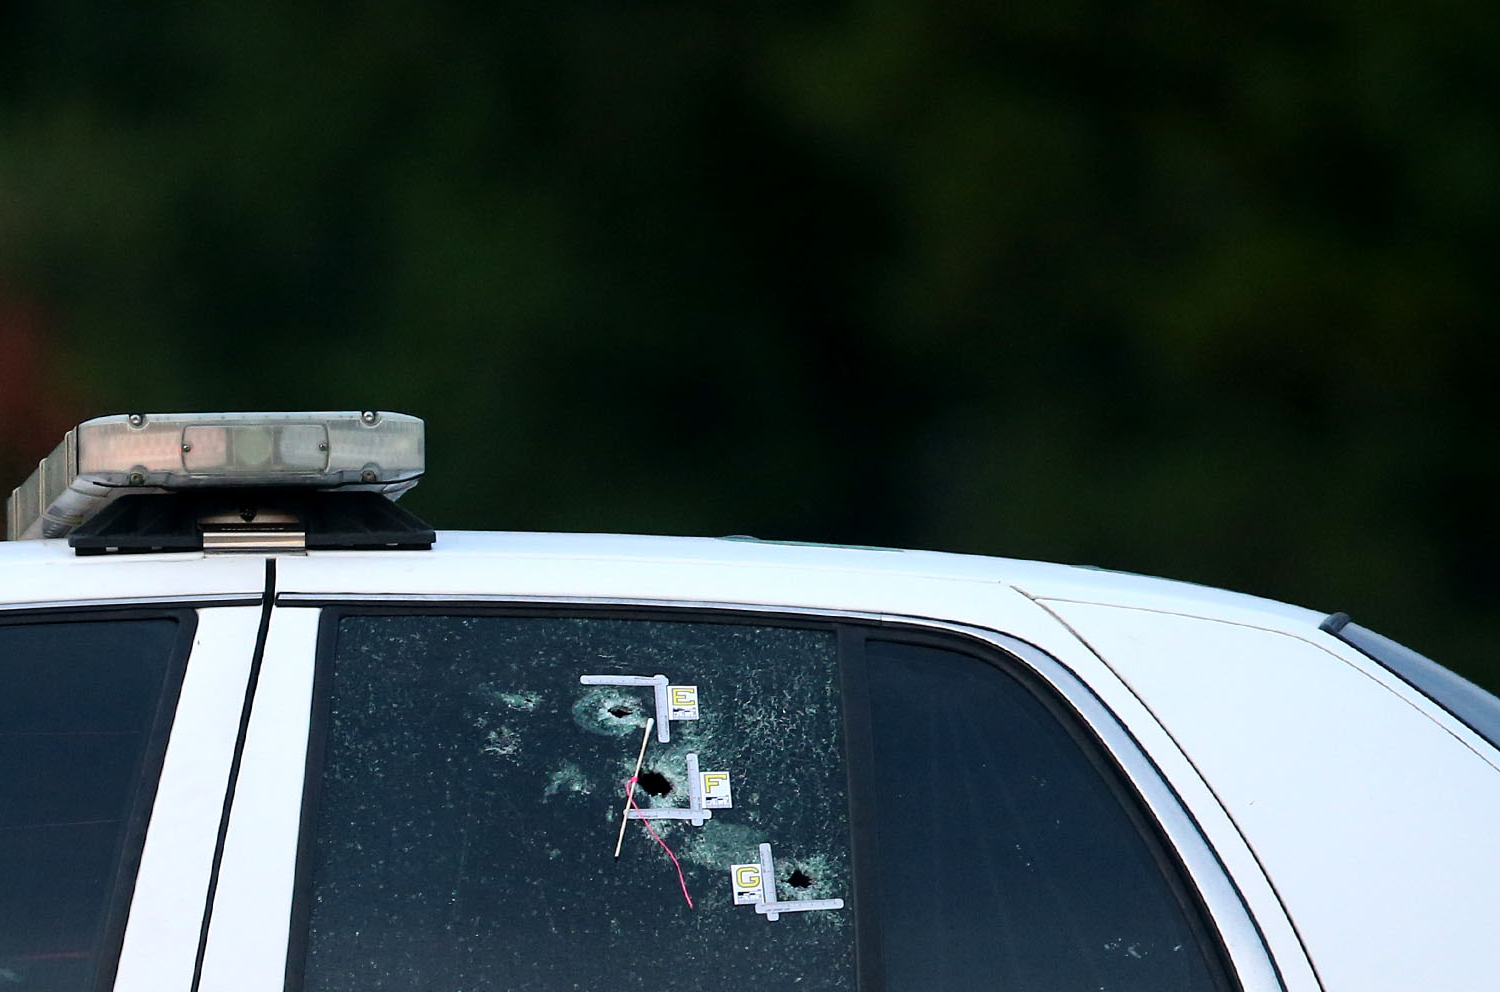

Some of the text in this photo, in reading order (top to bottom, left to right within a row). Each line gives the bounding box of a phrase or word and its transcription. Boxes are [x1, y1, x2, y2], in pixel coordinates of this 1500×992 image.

[672, 688, 696, 706] E
[704, 773, 728, 793] F
[736, 867, 760, 888] G
